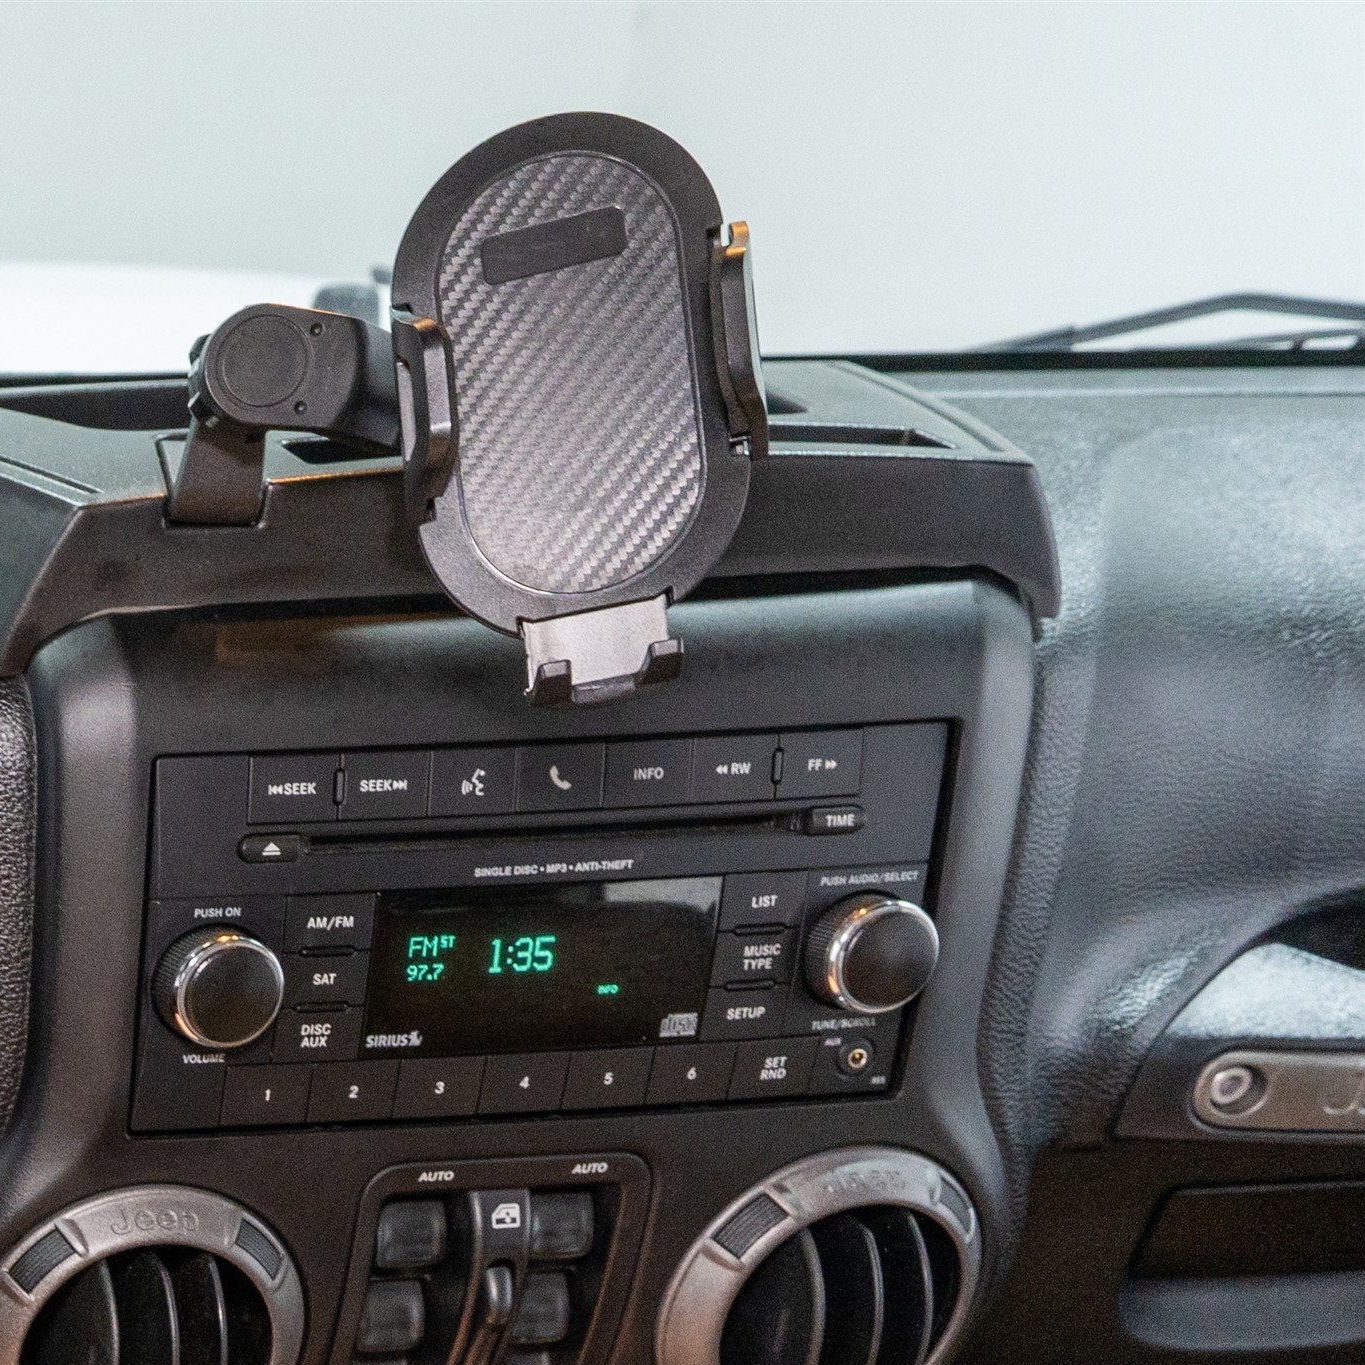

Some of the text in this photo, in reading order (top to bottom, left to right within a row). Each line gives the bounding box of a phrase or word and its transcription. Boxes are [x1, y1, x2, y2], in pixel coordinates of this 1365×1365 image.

[732, 762, 751, 775] RW
[808, 758, 823, 771] FF
[634, 767, 664, 781] INFO
[284, 783, 316, 795] SEEK
[360, 779, 392, 792] SEEK
[826, 814, 854, 827] TIME
[474, 859, 634, 878] SINGLE DISC MP3 ANTI-THEFT
[752, 895, 778, 908] LIST
[194, 907, 242, 919] PUSH ON
[307, 916, 354, 930] AM/FM
[408, 936, 439, 957] FM
[744, 944, 781, 958] MUSIC
[489, 936, 556, 974] 1:35
[743, 957, 772, 971] TYPE
[313, 973, 337, 986] SAT
[406, 964, 444, 982] 97.7
[727, 1007, 765, 1021] SETUP
[301, 1024, 331, 1036] DISC
[301, 1036, 328, 1048] AUX
[365, 1033, 408, 1048] SIRIUS
[183, 1054, 226, 1064] VOLUME
[765, 1057, 787, 1070] SET
[604, 1073, 613, 1085] 5
[687, 1067, 697, 1080] 6
[760, 1067, 787, 1080] RND
[435, 1082, 445, 1094] 3
[520, 1077, 530, 1089] 4
[264, 1089, 271, 1101] 1
[349, 1085, 360, 1098] 2
[572, 1163, 609, 1175] AUTO
[418, 1171, 455, 1183] AUTO
[110, 1208, 200, 1235] Jeep
